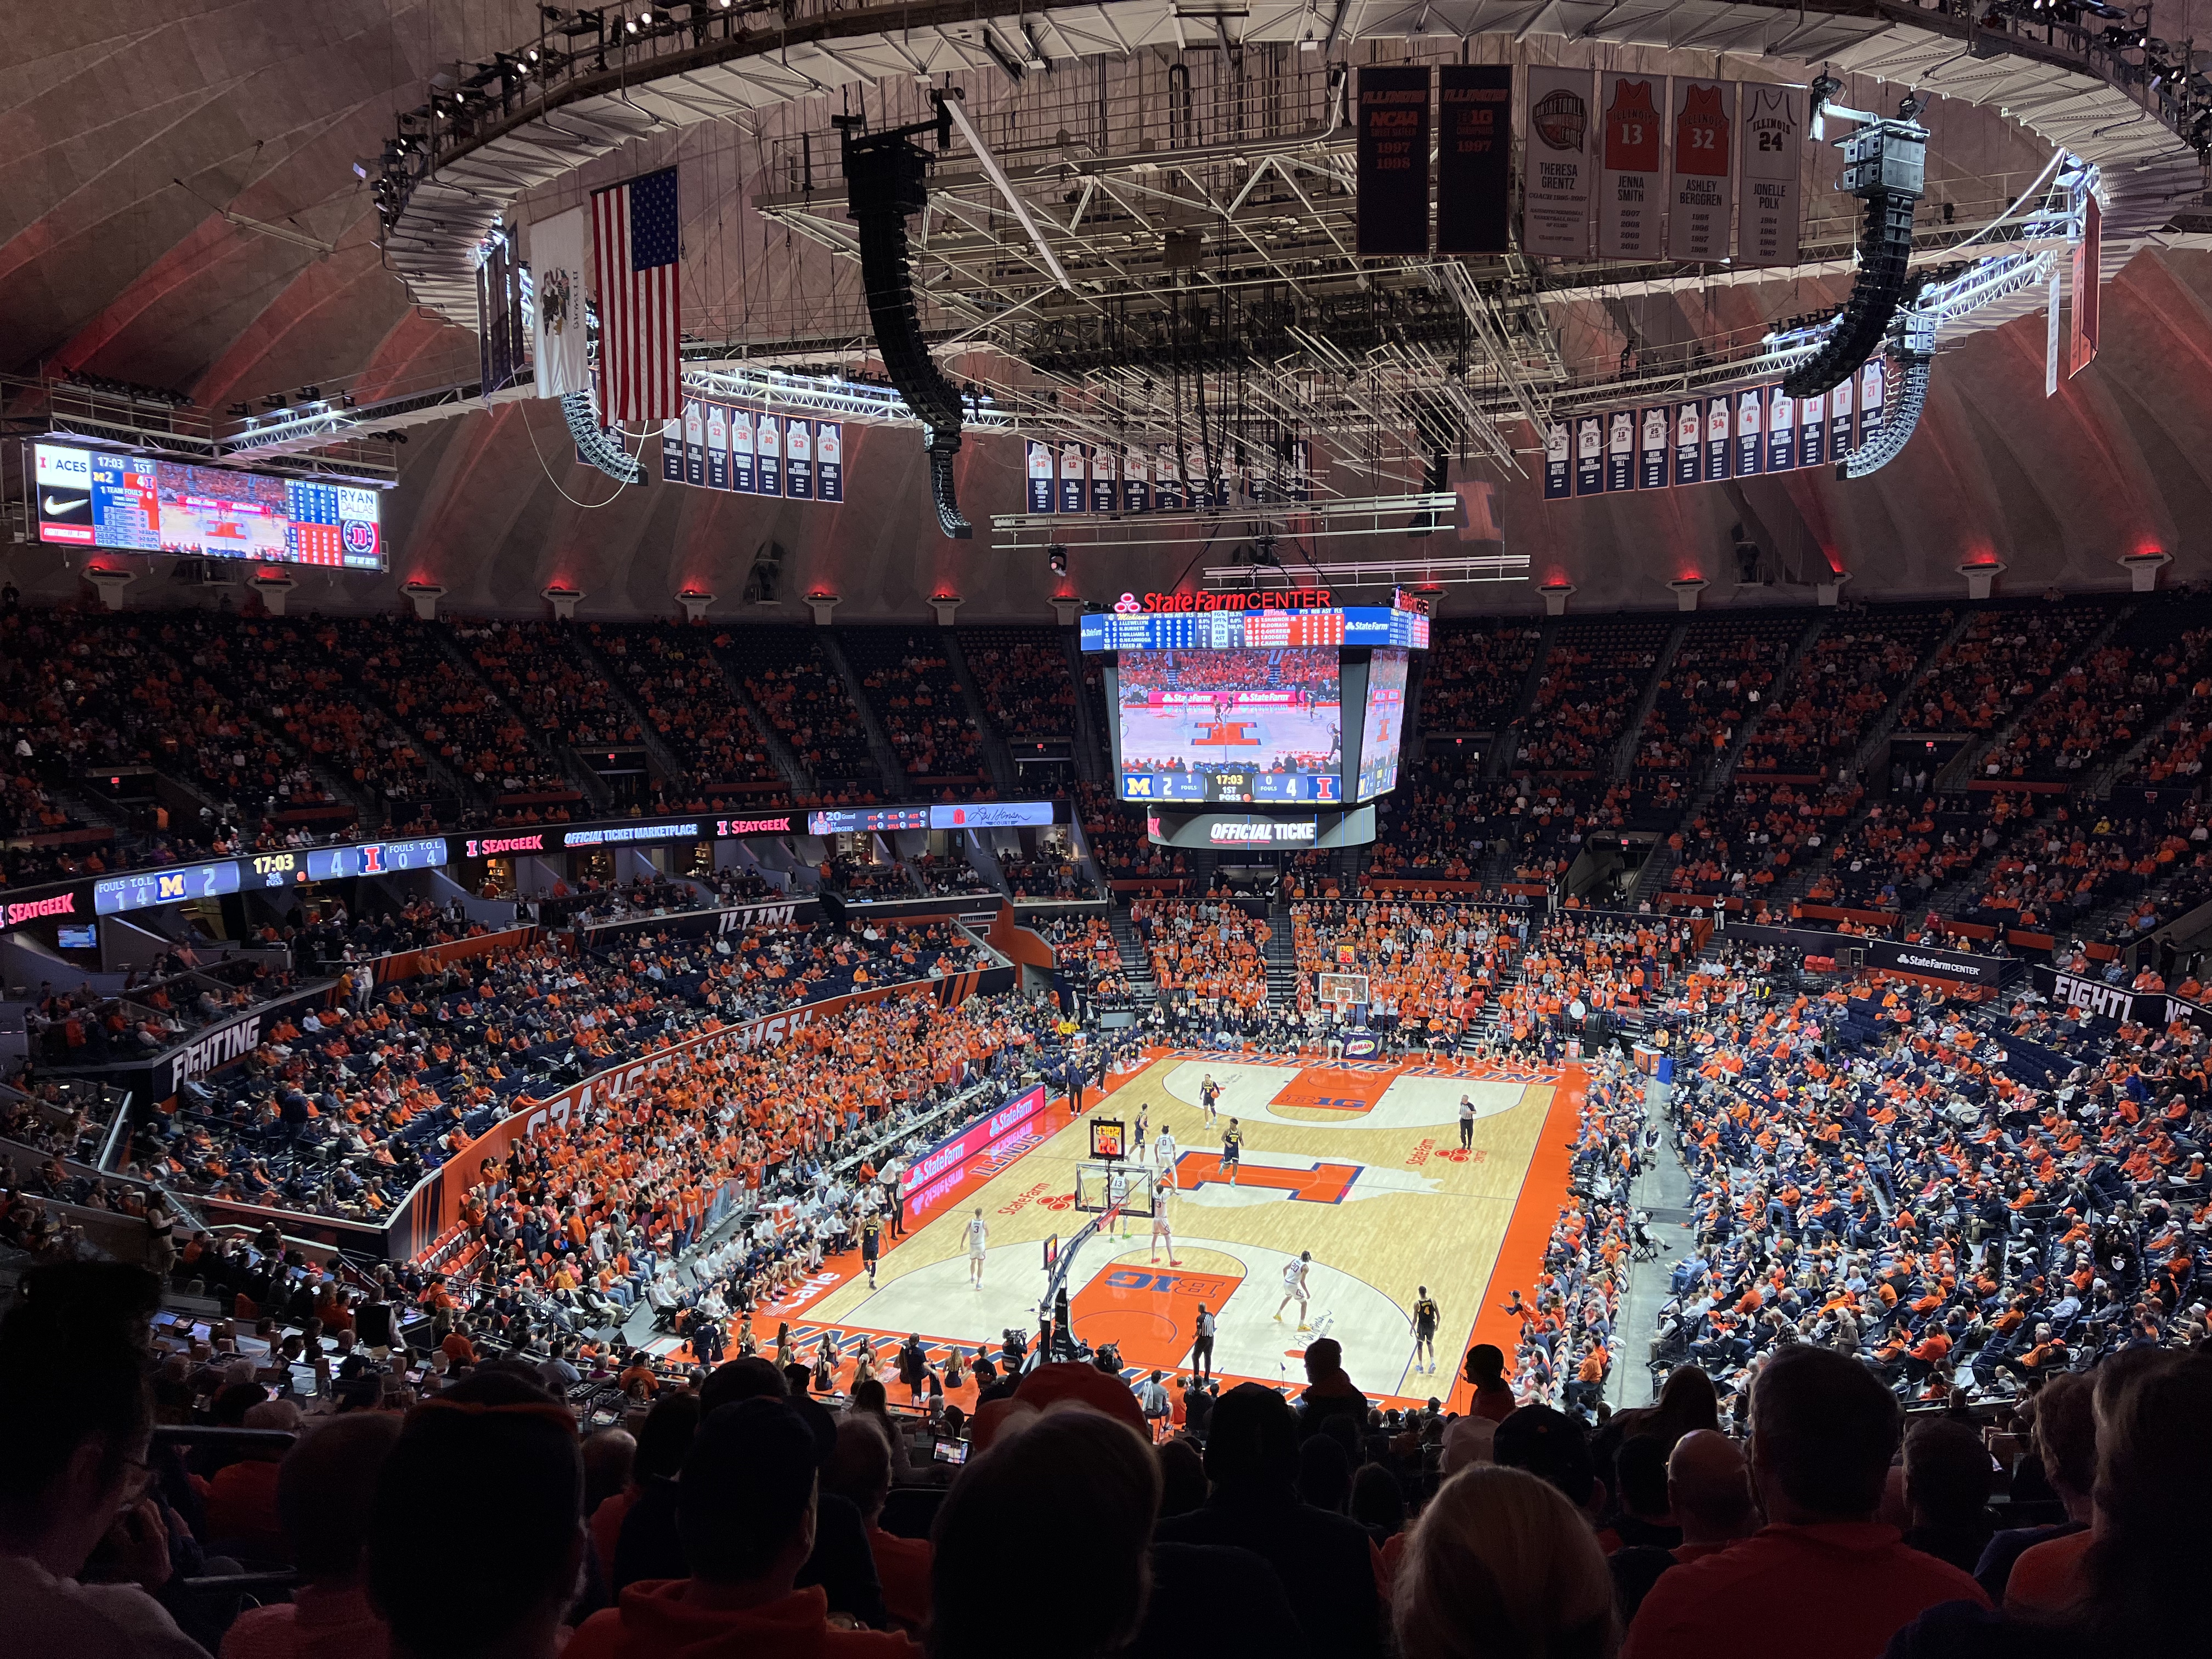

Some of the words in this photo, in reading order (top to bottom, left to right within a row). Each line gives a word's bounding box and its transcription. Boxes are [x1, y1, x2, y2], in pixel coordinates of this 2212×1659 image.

[1362, 90, 1426, 103] ILLINOIS
[1444, 89, 1508, 101] ILLINOIS
[1536, 97, 1583, 117] BASKETBALL
[1370, 111, 1418, 127] NCAA
[1613, 109, 1653, 125] ILLINOIS
[1684, 114, 1723, 129] ILLINOIS
[1753, 117, 1791, 134] ILLINOIS
[1561, 127, 1581, 149] FAME
[1622, 123, 1643, 144] 13
[1692, 128, 1714, 149] 32
[1759, 131, 1783, 151] 24
[1378, 142, 1410, 153] 1997
[1458, 140, 1492, 152] 1997
[1540, 162, 1577, 177] THERESA
[1542, 176, 1575, 189] GRENTZ
[1618, 176, 1644, 189] JENNA
[1686, 179, 1717, 193] ASHLEY
[1753, 183, 1786, 197] JONELLE
[1618, 189, 1644, 201] SMITH
[1680, 192, 1722, 206] BERGGREN
[1759, 196, 1779, 209] POLK
[1839, 392, 1846, 404] 11
[1867, 385, 1875, 397] 21
[1809, 401, 1818, 411] 11
[1712, 419, 1725, 430] 34
[1746, 414, 1753, 423] 4
[690, 422, 697, 432] 37
[713, 427, 721, 437] 22
[1683, 424, 1695, 435] 30
[738, 432, 747, 440] 35
[40, 456, 46, 468] I
[55, 459, 87, 472] ACES
[98, 456, 124, 469] 17:03
[133, 464, 153, 473] 1ST
[93, 471, 105, 482] M
[105, 471, 114, 483] 2
[137, 476, 144, 486] 4
[107, 486, 123, 494] TEAM
[124, 488, 143, 496] FOULS
[341, 489, 374, 504] RYAN
[341, 501, 374, 514] DALLAS
[352, 527, 367, 545] JJ
[1247, 590, 1331, 609] CENTER
[1128, 777, 1150, 795] M
[1163, 777, 1172, 795] 2
[1216, 775, 1243, 785] 17:03
[1286, 778, 1297, 797] 4
[1317, 778, 1332, 799] I
[826, 811, 842, 821] 20
[717, 821, 727, 835] I
[731, 817, 791, 834] SEATGEEK
[1211, 823, 1272, 840] OFFICIAL
[1273, 822, 1316, 839] TICKE
[564, 831, 603, 845] OFFICIAL
[603, 828, 634, 842] TICKET
[635, 823, 697, 839] MARKETPLACE
[389, 843, 414, 854] FOULS
[419, 839, 442, 851] T.O.L.
[466, 840, 478, 857] I
[482, 834, 544, 855] SEATGEEK
[253, 854, 295, 874] 17:03
[330, 852, 343, 877] 4
[364, 847, 380, 872] I
[398, 853, 408, 868] 0
[427, 850, 437, 865] 4
[99, 880, 125, 893] FOULS
[160, 874, 184, 898] M
[203, 868, 216, 897] 2
[266, 878, 284, 887] POSS
[116, 891, 125, 910] 1
[136, 888, 147, 905] 4
[8, 893, 75, 924] SEATGEEK
[718, 906, 795, 934] ILLINI
[1339, 951, 1352, 963] 26
[1951, 964, 1980, 975] CENTER
[172, 1016, 261, 1093] FIGHTING
[1346, 1041, 1372, 1056] LIBMAN
[1164, 1050, 1401, 1073] FIGHTING
[1400, 1066, 1561, 1084] ILLINI
[1097, 1125, 1120, 1137] 17:02
[1098, 1136, 1118, 1154] 26
[968, 1133, 1045, 1177] ILLINOIS
[1290, 1262, 1300, 1273] 20
[785, 1272, 840, 1308] Carle
